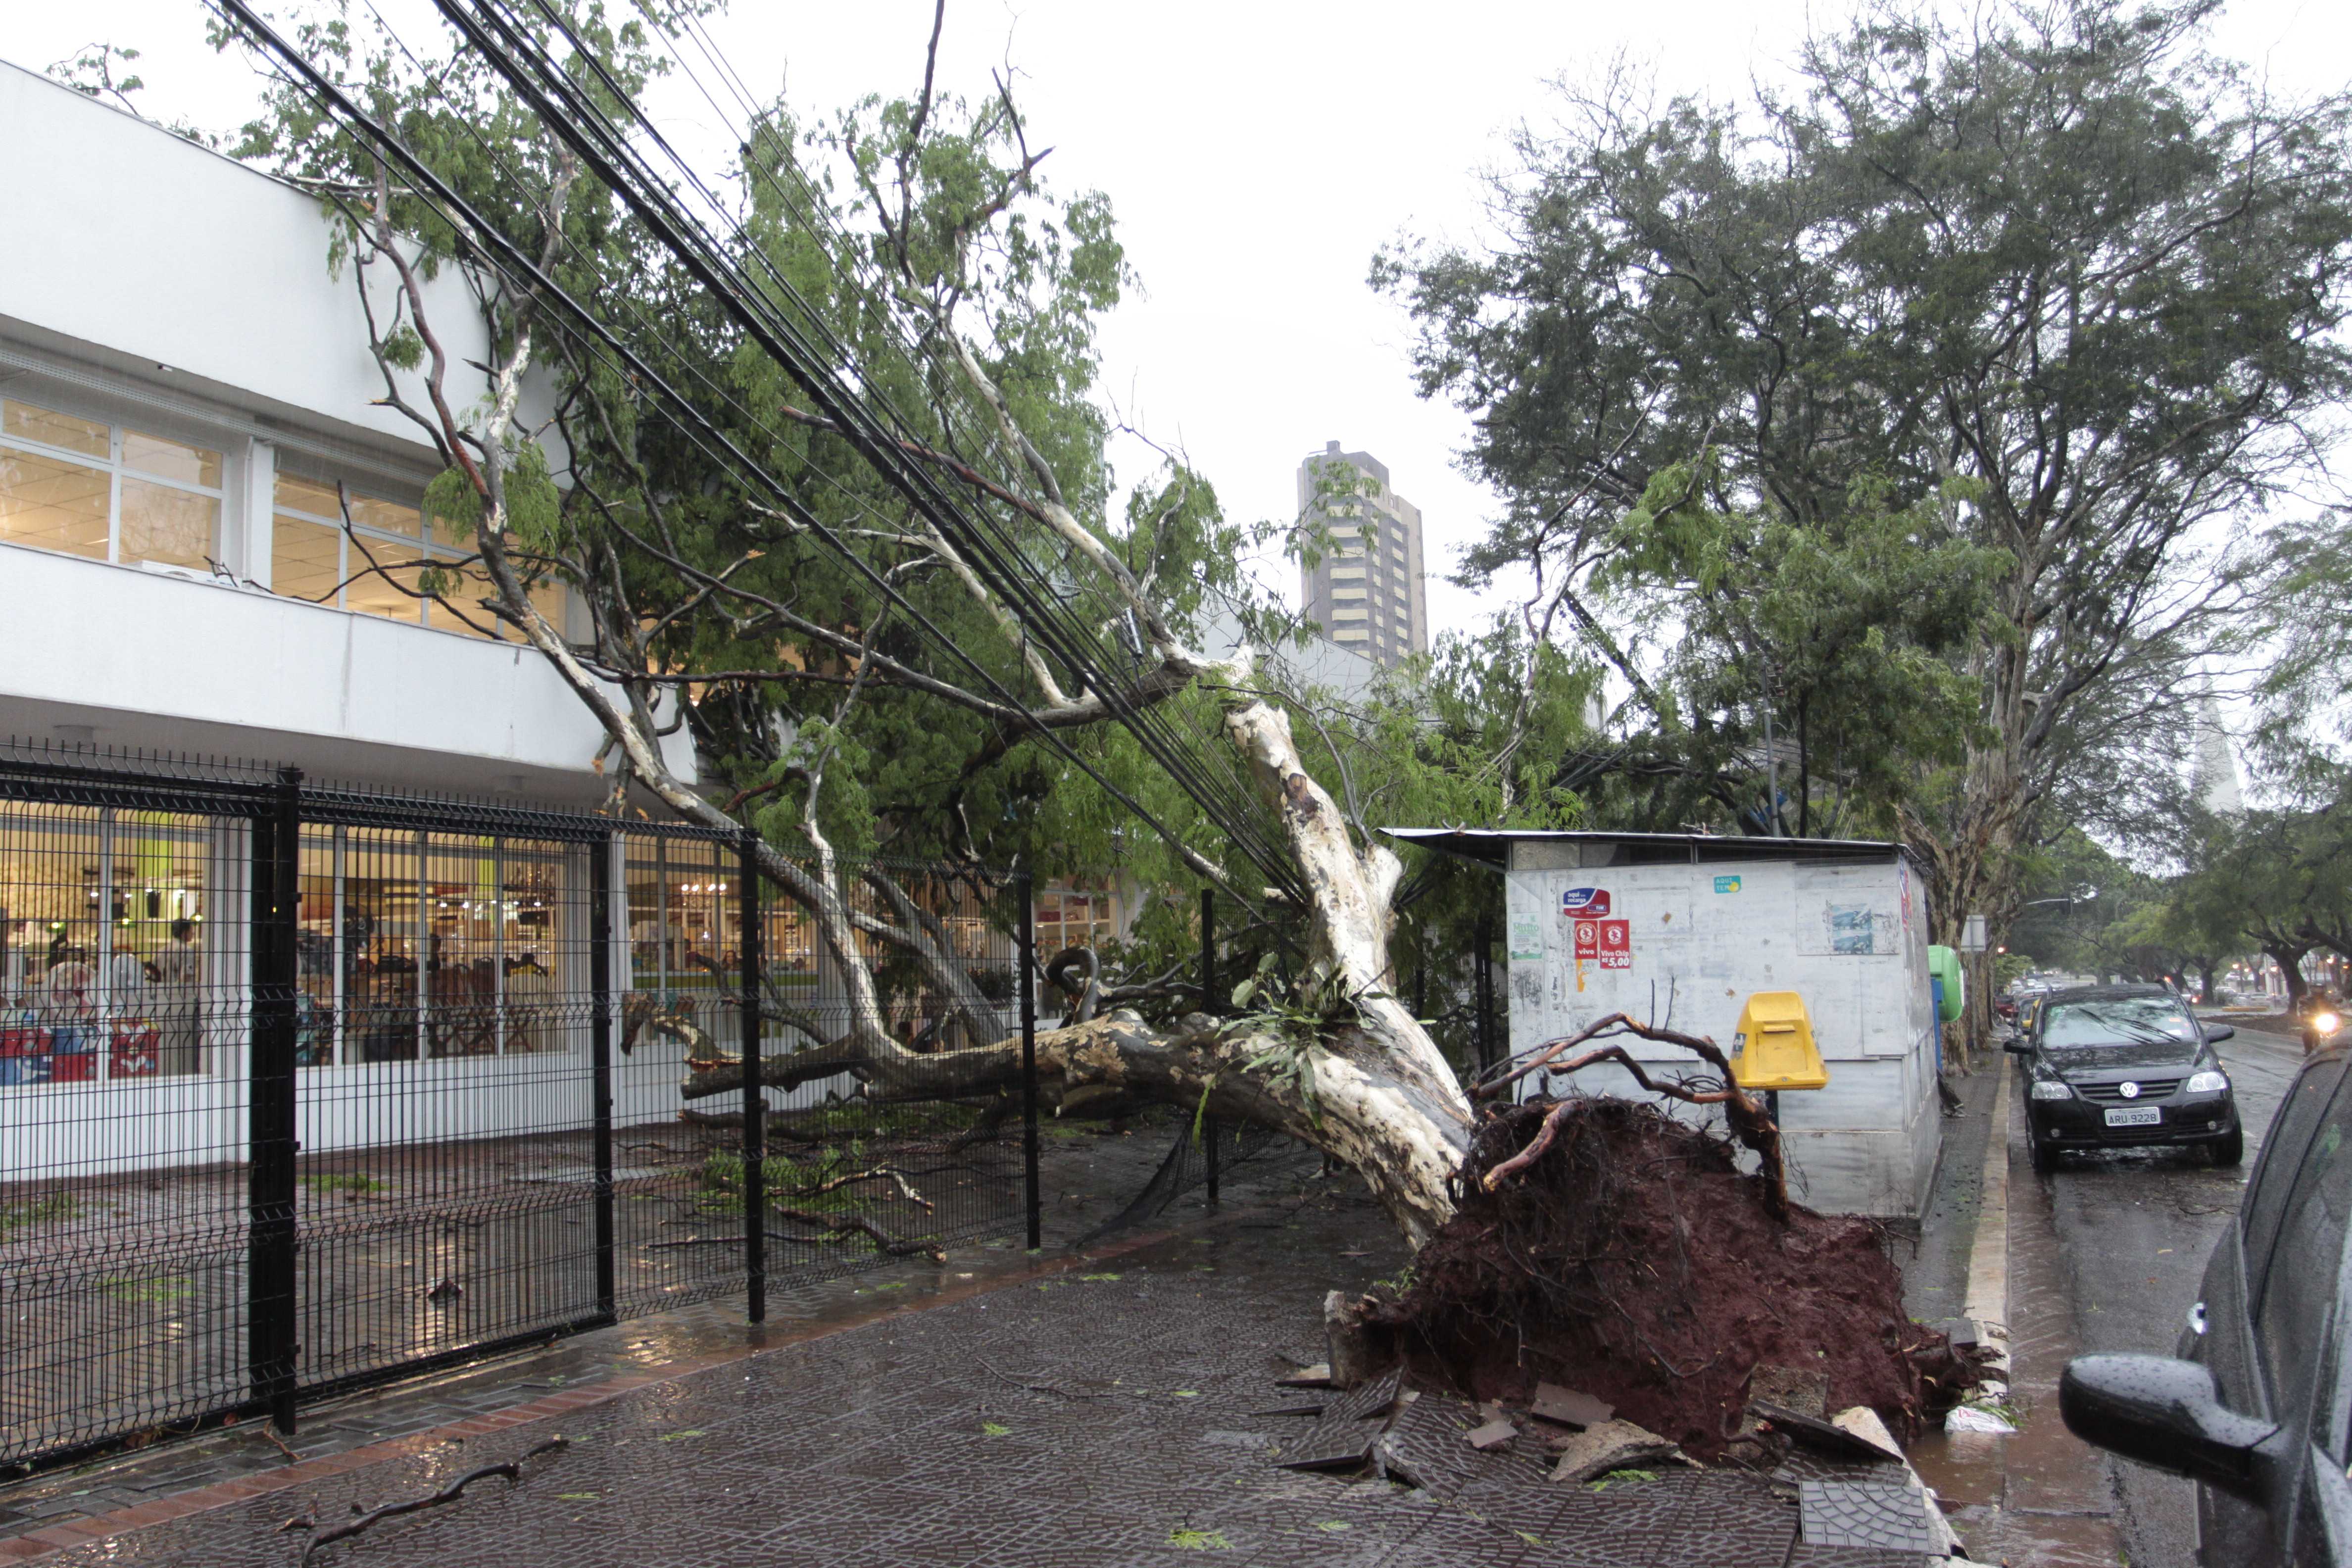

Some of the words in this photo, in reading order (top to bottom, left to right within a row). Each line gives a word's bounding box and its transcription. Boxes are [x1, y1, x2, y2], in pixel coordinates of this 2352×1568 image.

[1615, 950, 1630, 958] Chip
[1608, 957, 1630, 968] 5,00
[2109, 1115, 2128, 1125] ARU
[2131, 1113, 2156, 1124] 9228
